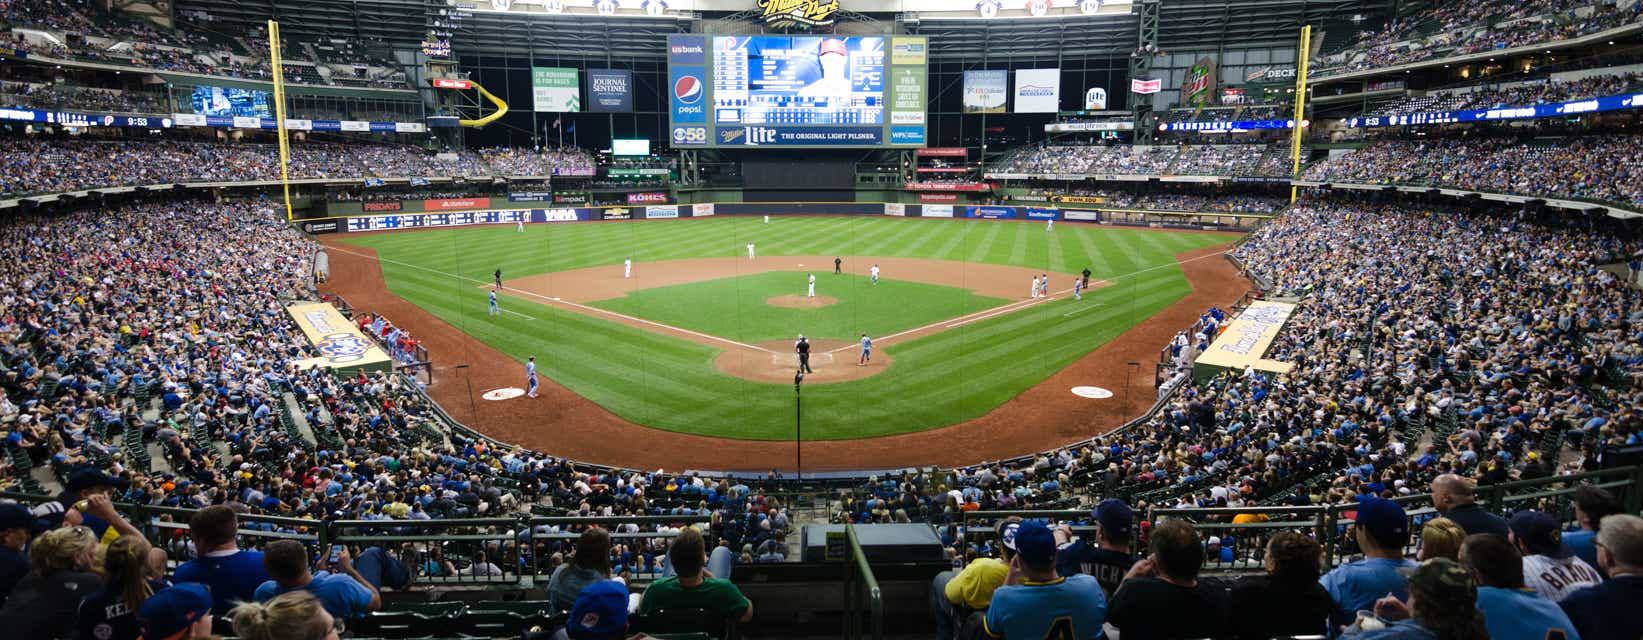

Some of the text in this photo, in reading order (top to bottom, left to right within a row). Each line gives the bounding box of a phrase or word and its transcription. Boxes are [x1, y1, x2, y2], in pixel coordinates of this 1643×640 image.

[1267, 69, 1297, 78] DECK
[593, 78, 627, 86] JOURNAL
[679, 105, 702, 114] pepsi
[128, 118, 148, 126] 9:53
[1365, 117, 1379, 126] 9:53
[685, 127, 706, 141] 58
[744, 126, 777, 146] Lite
